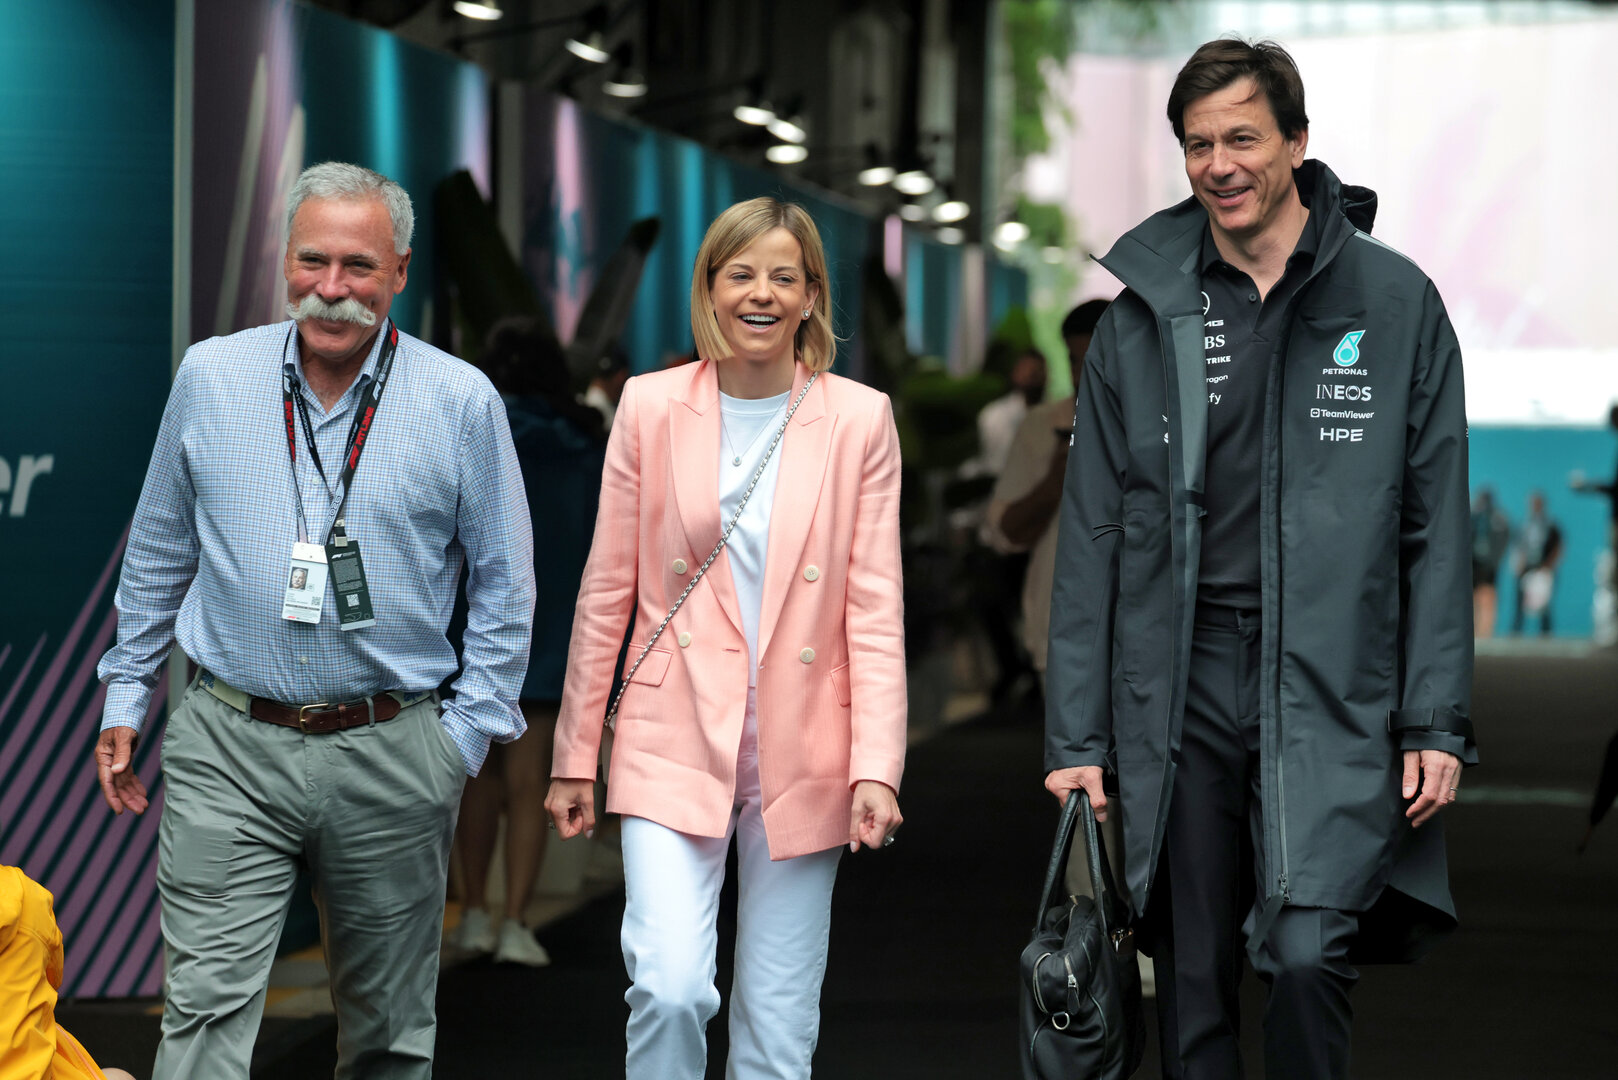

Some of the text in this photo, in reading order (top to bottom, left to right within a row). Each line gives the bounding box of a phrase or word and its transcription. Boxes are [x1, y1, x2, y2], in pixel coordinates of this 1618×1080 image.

[1204, 334, 1225, 350] BS
[1206, 355, 1231, 365] TRIKE
[1322, 368, 1368, 376] PETRONAS
[1208, 392, 1222, 405] fy
[1316, 384, 1372, 402] INEOS
[1320, 409, 1375, 419] TeamViewer
[1320, 427, 1364, 442] HPE
